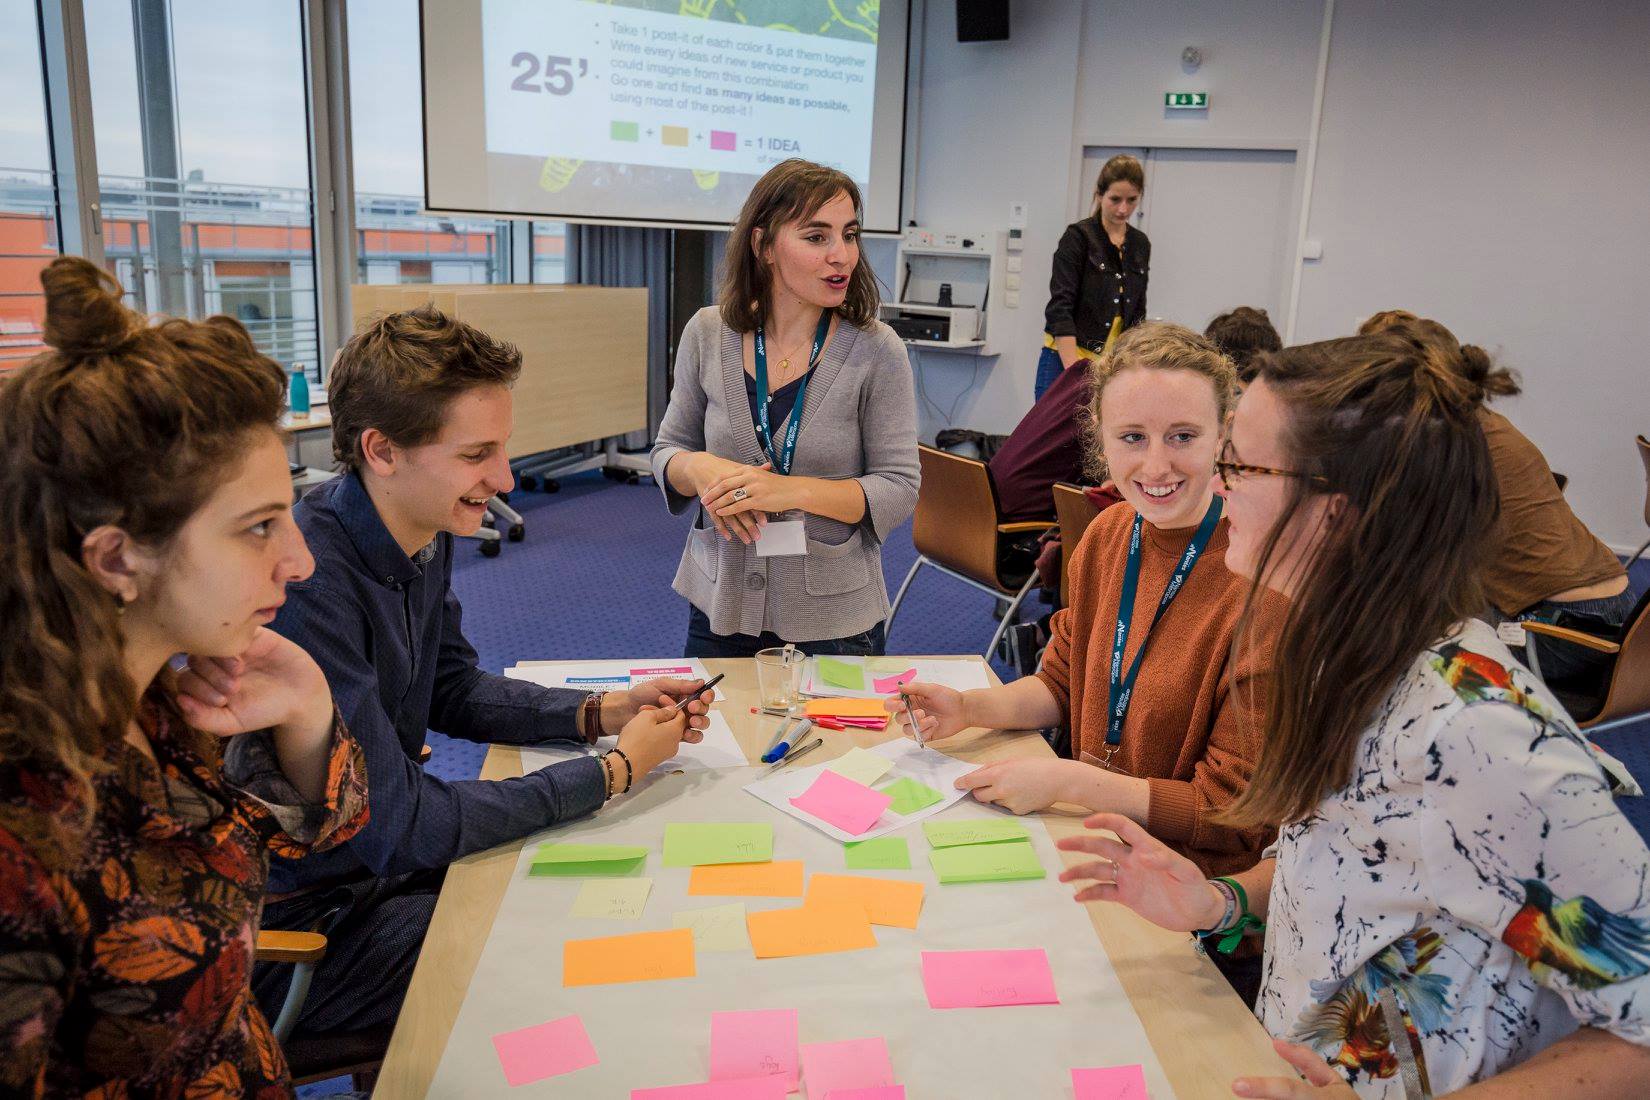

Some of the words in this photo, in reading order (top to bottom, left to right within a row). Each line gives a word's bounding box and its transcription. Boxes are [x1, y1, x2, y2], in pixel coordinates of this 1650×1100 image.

[610, 21, 638, 36] Take
[652, 29, 689, 44] post-it
[692, 34, 704, 45] of
[706, 37, 733, 49] each
[736, 41, 763, 53] color
[776, 46, 794, 58] put
[796, 48, 822, 61] them
[825, 53, 866, 68] together
[610, 39, 641, 53] Write
[644, 45, 675, 60] every
[679, 47, 709, 63] ideas
[712, 54, 722, 64] of
[725, 56, 748, 67] new
[751, 59, 788, 73] service
[790, 65, 801, 74] or
[803, 67, 843, 81] product
[845, 72, 864, 84] you
[610, 58, 643, 71] could
[647, 60, 691, 78] imagine
[695, 66, 719, 80] from
[722, 70, 741, 83] this
[745, 74, 808, 92] combination
[610, 92, 642, 107] using
[645, 96, 674, 109] most
[677, 99, 688, 109] of
[691, 100, 709, 112] the
[611, 73, 628, 86] Go
[632, 78, 653, 89] one
[656, 80, 678, 92] and
[681, 82, 701, 94] find
[705, 86, 718, 96] as
[722, 89, 753, 102] many
[755, 90, 785, 105] ideas
[787, 96, 800, 106] as
[758, 137, 763, 149] 1
[768, 138, 800, 152] IDEA
